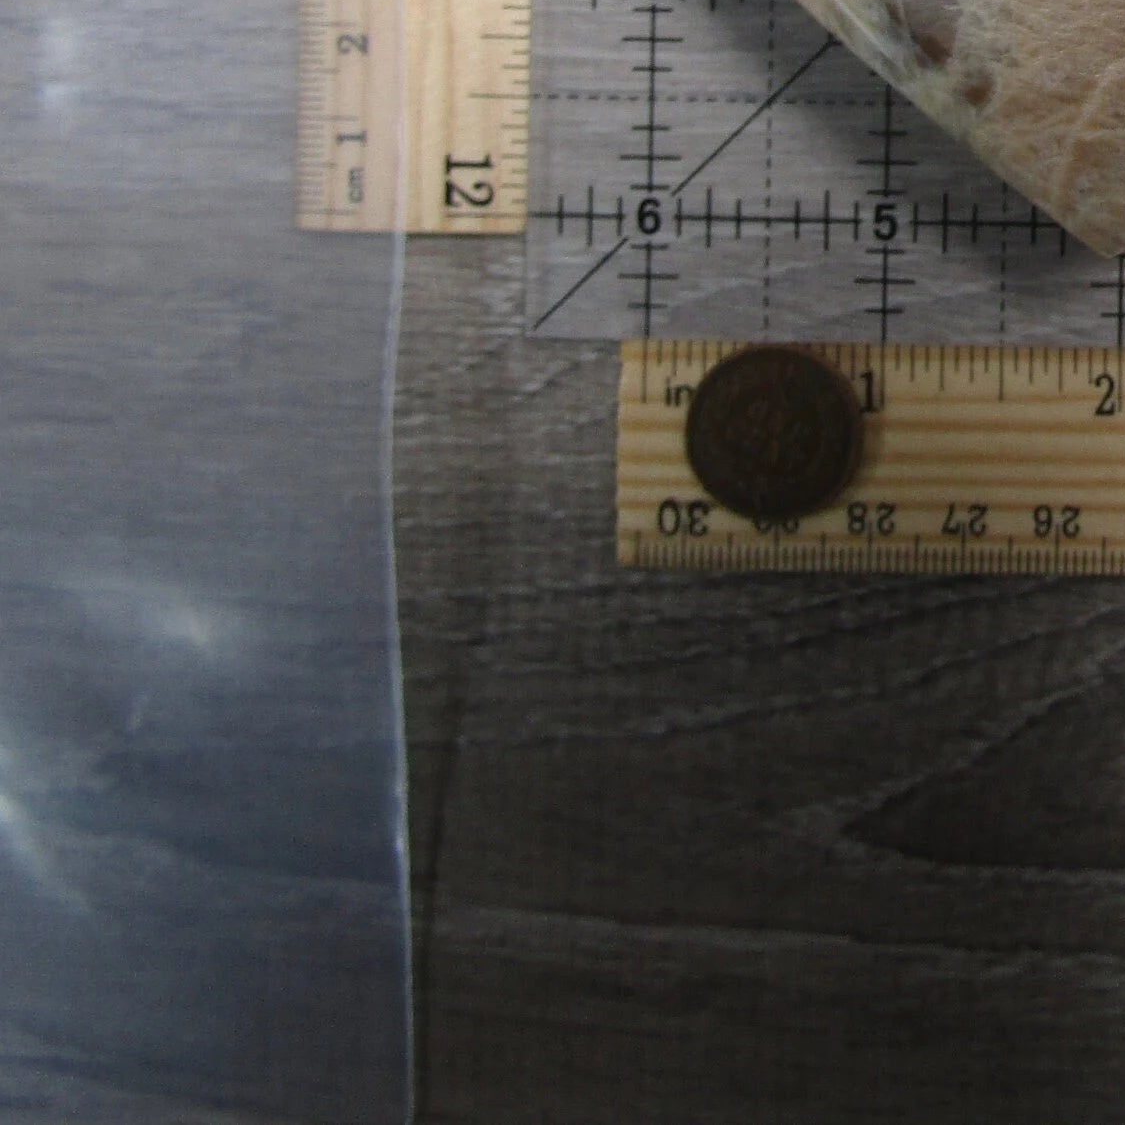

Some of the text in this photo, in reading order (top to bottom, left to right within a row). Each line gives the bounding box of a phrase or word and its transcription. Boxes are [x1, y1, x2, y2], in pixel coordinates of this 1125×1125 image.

[336, 33, 370, 56] 2
[336, 130, 368, 148] 1
[444, 153, 496, 209] 12
[637, 196, 662, 235] 6
[872, 202, 898, 242] 5
[860, 370, 880, 414] 1
[1093, 374, 1117, 417] 2
[657, 498, 712, 537] 30
[847, 501, 897, 536] 28
[940, 503, 989, 537] 27
[1033, 504, 1082, 539] 26
